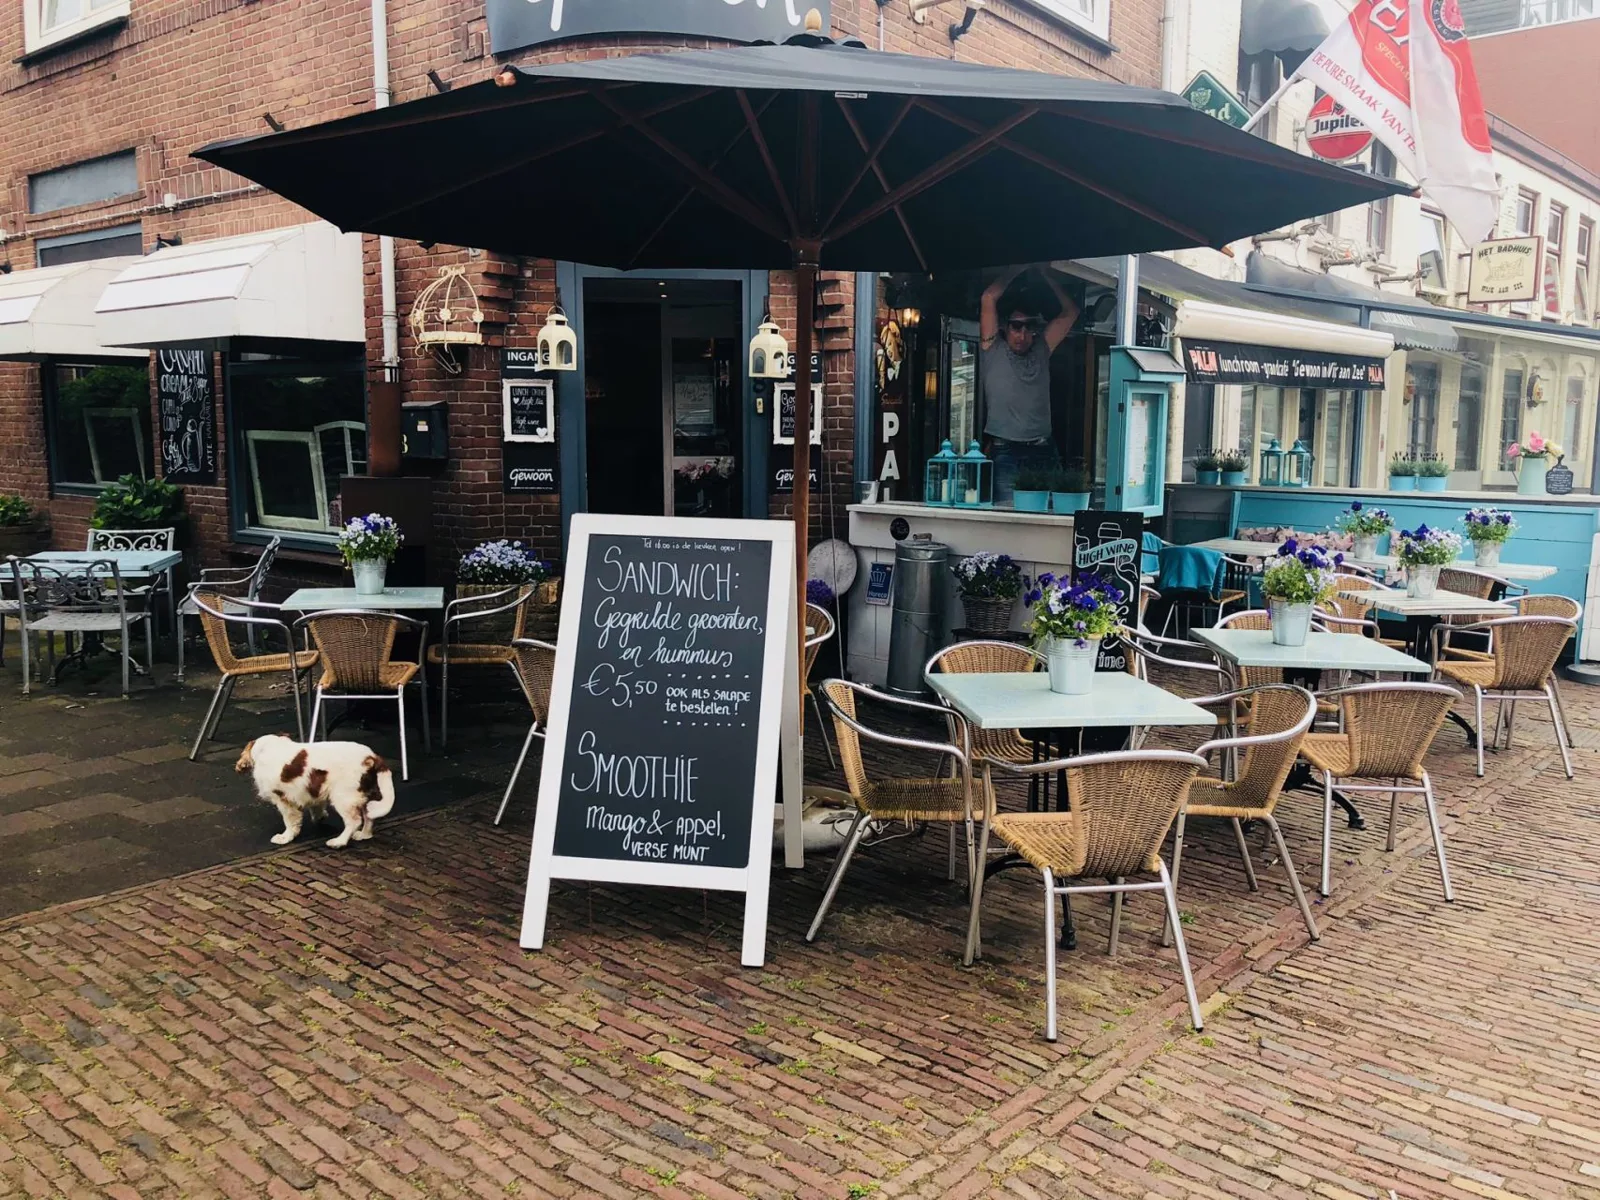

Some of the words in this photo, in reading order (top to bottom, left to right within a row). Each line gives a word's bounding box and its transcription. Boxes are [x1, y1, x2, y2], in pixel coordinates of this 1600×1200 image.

[1312, 51, 1326, 65] DE
[1321, 58, 1346, 81] PURE
[1341, 75, 1382, 112] SMAAK
[1381, 107, 1406, 135] VAN
[1312, 114, 1365, 134] Jupile
[1478, 247, 1493, 258] HET
[1497, 244, 1532, 255] BADHUIS
[1188, 349, 1218, 373] PALM
[509, 468, 554, 487] Gewoon
[672, 542, 680, 550] is
[681, 541, 691, 550] de
[1078, 549, 1104, 566] HIGH
[597, 545, 740, 602] SANDWICH:
[594, 597, 682, 649] Gegrilde
[688, 605, 763, 649] groenten,
[619, 645, 644, 668] en
[648, 636, 733, 668] hummus
[666, 686, 688, 699] OOK
[691, 688, 710, 700] ALS
[665, 699, 677, 712] te
[680, 699, 731, 716] bestellen
[586, 805, 647, 851] Mango
[631, 841, 669, 859] VERSE
[672, 844, 710, 862] MUNT
